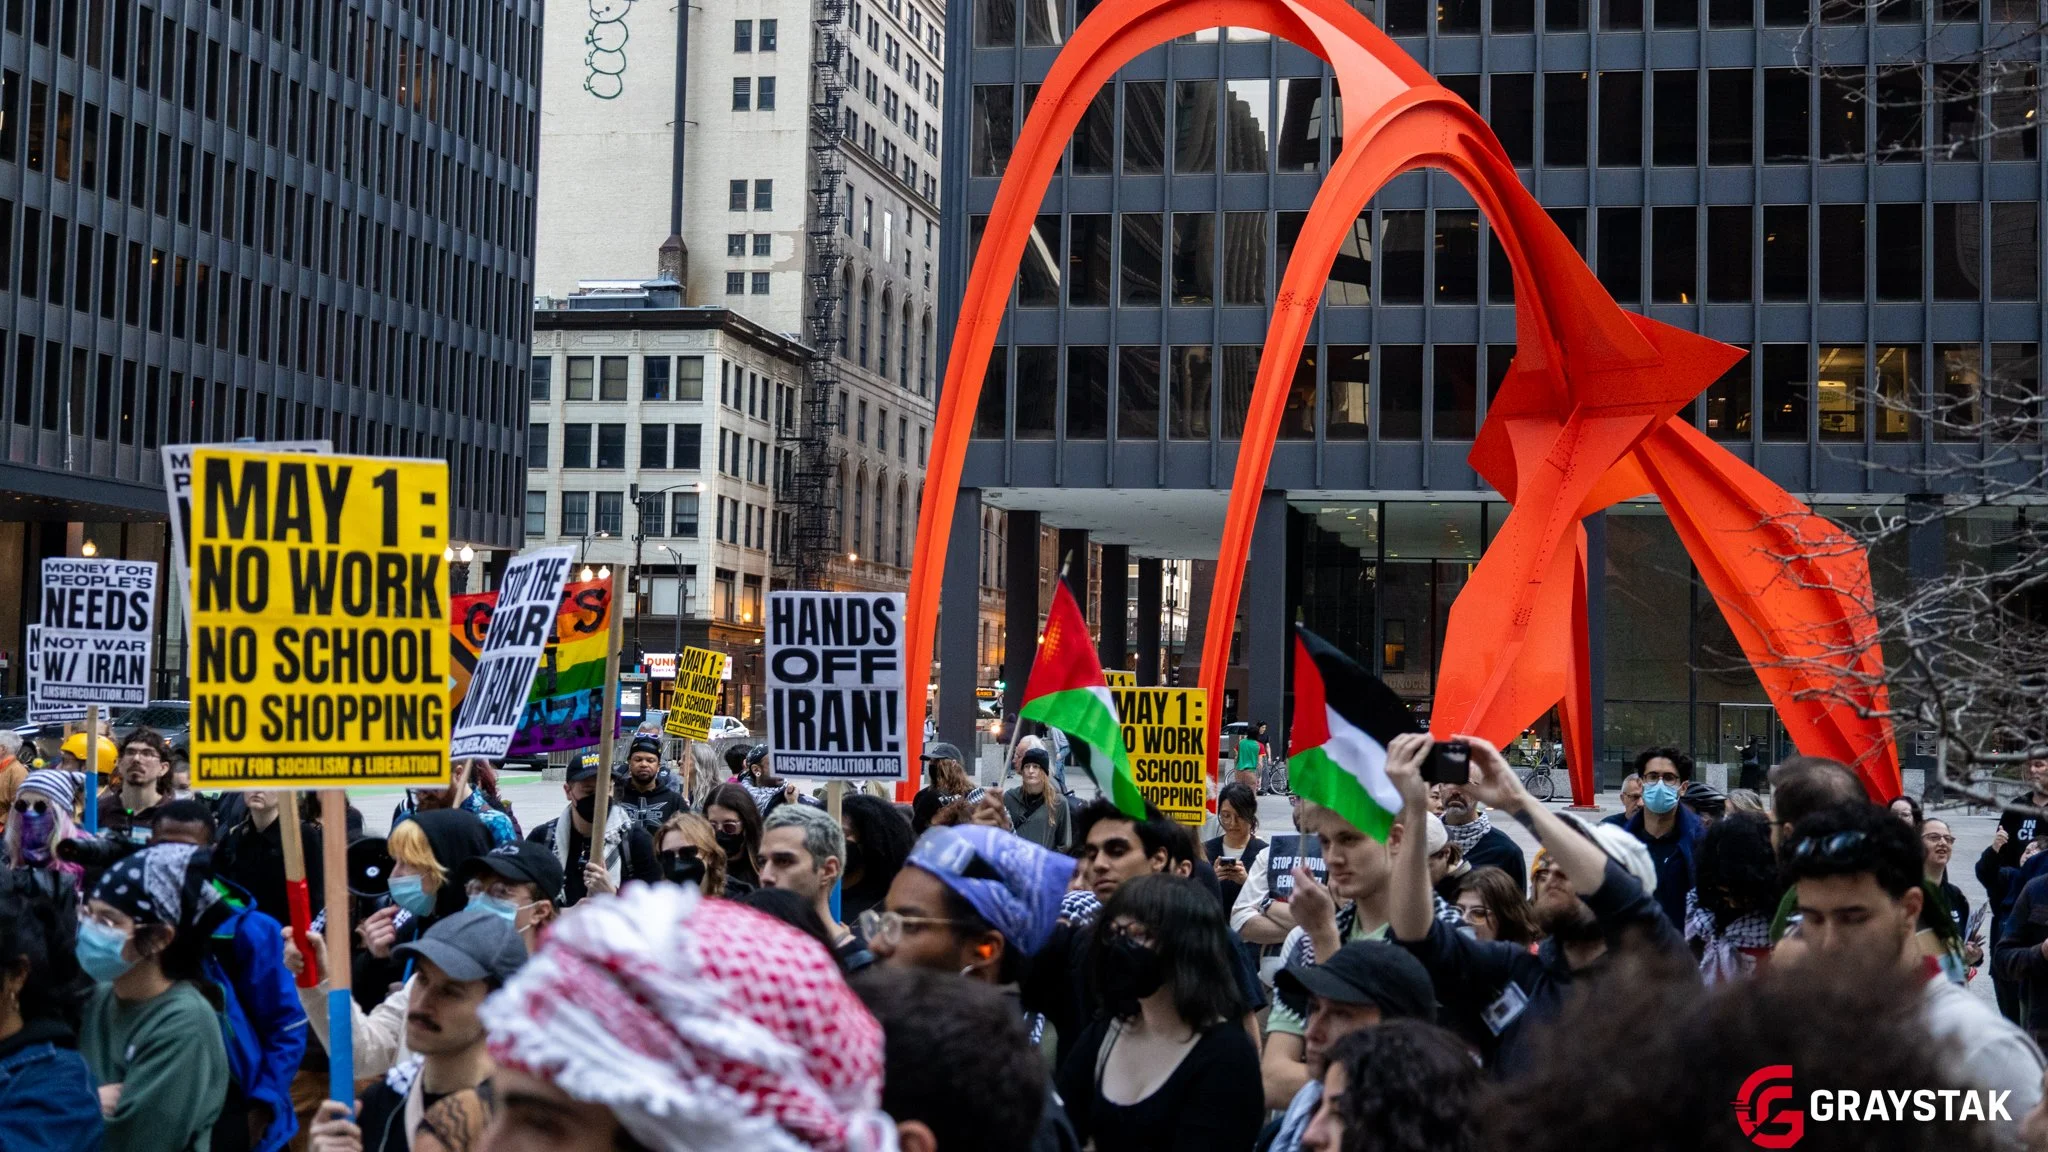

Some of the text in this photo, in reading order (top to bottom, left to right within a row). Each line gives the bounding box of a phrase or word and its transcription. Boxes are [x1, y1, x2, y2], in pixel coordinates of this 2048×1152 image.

[204, 458, 352, 544] MAY
[45, 563, 152, 576] MONEY FOR
[45, 574, 152, 589] PEOPLE'S
[198, 545, 443, 619] NO WORK
[499, 558, 568, 608] STOP THE
[44, 587, 150, 632] NEEDS
[772, 597, 896, 646] HANDS
[487, 604, 549, 651] WAR
[44, 637, 88, 649] NOT
[94, 639, 146, 652] WAR
[198, 626, 443, 684] NO SCHOOL
[44, 651, 79, 682] W/
[87, 652, 145, 685] IRAN
[647, 657, 676, 667] DUNK
[681, 648, 708, 673] MAY
[772, 647, 897, 685] OFF
[42, 685, 143, 702] ANSWERCOALITION.ORG
[677, 672, 719, 697] NO WORK
[673, 691, 713, 715] NO SCHOOL
[1111, 691, 1168, 725] MAY
[197, 693, 443, 742] NO SHOPPING
[669, 709, 712, 730] NO SHOPPING
[773, 688, 899, 752] IRAN!
[1142, 726, 1204, 755] WORK
[201, 756, 439, 778] PARTY FOR SOCIALISM & LIBERATION
[776, 755, 899, 774] ANSWERCOALITION.ORG
[1136, 758, 1203, 784] SCHOOL
[2023, 819, 2037, 829] IN
[1272, 856, 1292, 870] STOP
